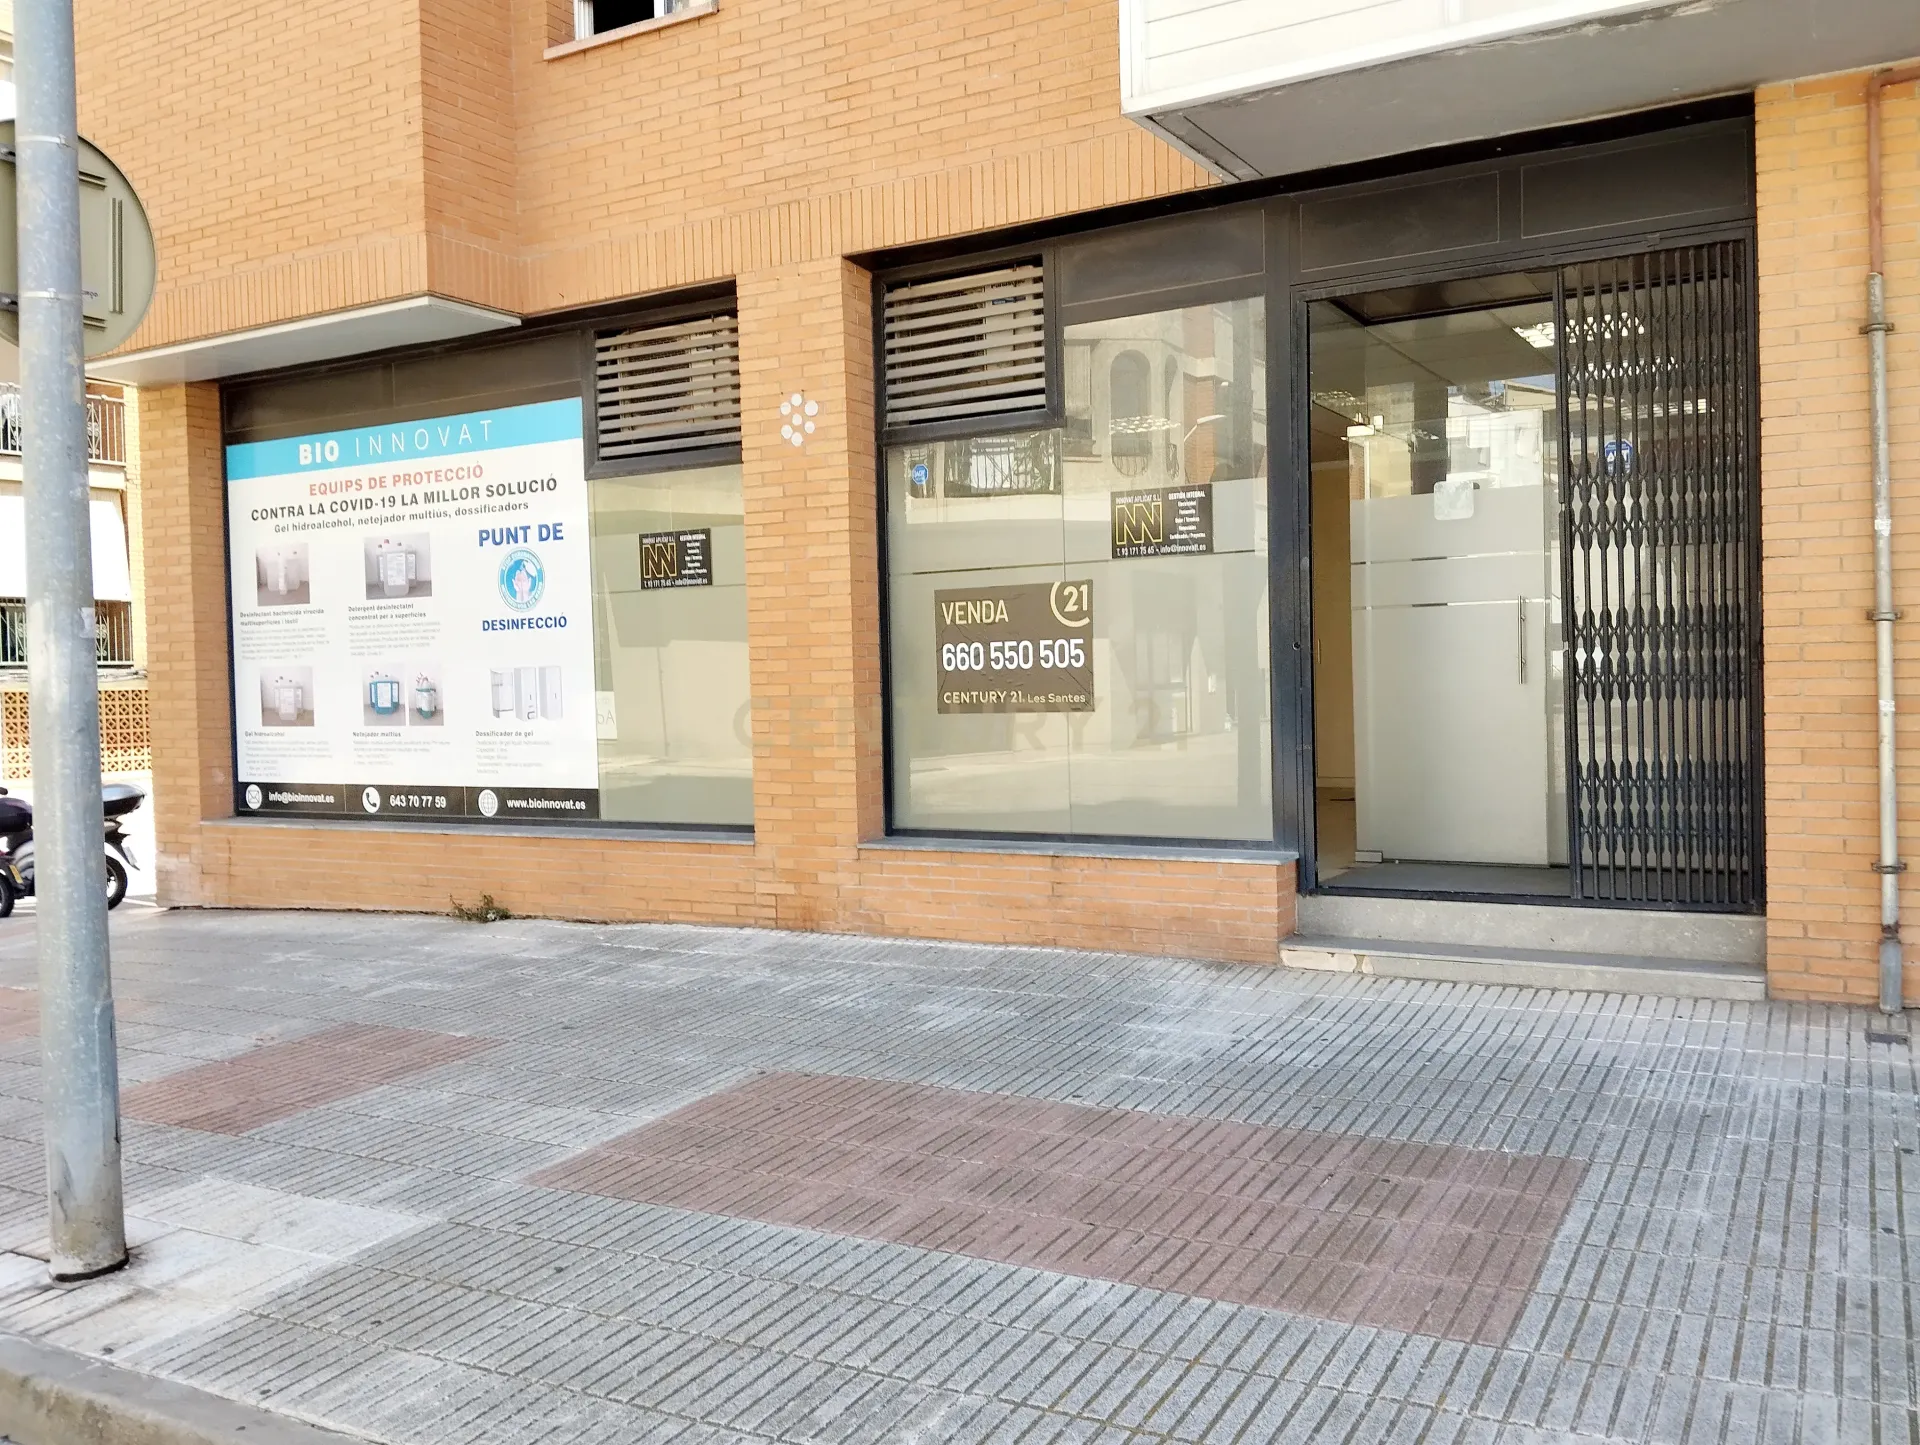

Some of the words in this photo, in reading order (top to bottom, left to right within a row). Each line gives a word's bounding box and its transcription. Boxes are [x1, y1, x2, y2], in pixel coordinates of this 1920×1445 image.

[298, 440, 339, 465] BIO
[355, 419, 492, 458] INNOVAT
[309, 478, 363, 496] EQUIPS
[368, 476, 387, 490] DE
[392, 460, 483, 487] PROTECCIÓ
[251, 505, 304, 521] CONTRA
[309, 503, 325, 516] LA
[330, 495, 396, 514] COVID-19
[401, 493, 418, 507] LA
[423, 486, 480, 505] MILLOR
[486, 473, 557, 498] SOLUCIÓ
[274, 523, 289, 533] Gel
[292, 515, 355, 532] hidroalcohol,
[357, 514, 405, 527] netejador
[454, 501, 529, 516] dossificadors
[478, 525, 531, 547] PUNT
[538, 522, 564, 542] DE
[1129, 546, 1139, 555] 171
[941, 599, 1009, 625] VENDA
[1063, 584, 1089, 612] 21
[482, 611, 568, 632] DESINFECCIÓ
[942, 641, 985, 672] 660
[989, 640, 1034, 671] 550
[1039, 638, 1085, 669] 505
[943, 690, 1007, 704] CENTURY
[1027, 693, 1045, 704] Les
[1048, 692, 1086, 704] Santes
[268, 791, 335, 804] info@bioinnovat.es
[389, 794, 407, 807] 643
[408, 795, 420, 808] 70
[421, 795, 433, 808] 77
[434, 795, 447, 808] 59
[506, 797, 586, 810] www.bioinnovat.es
